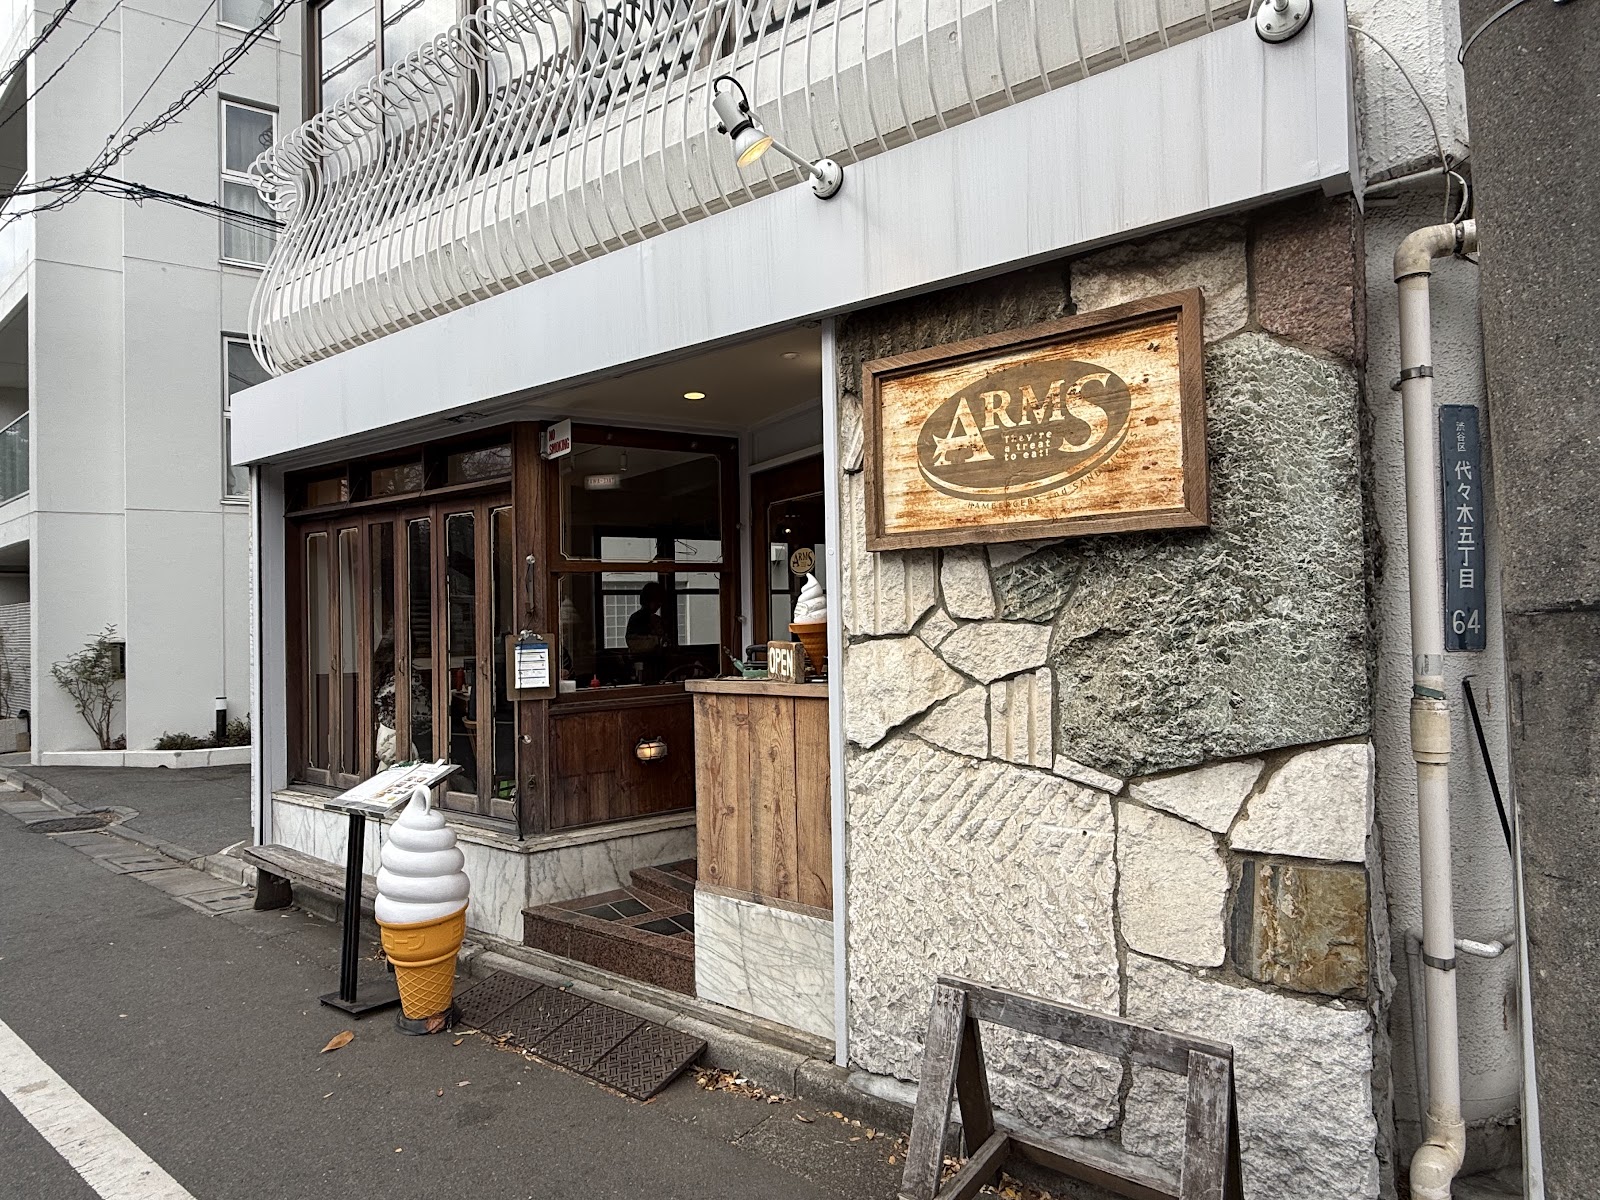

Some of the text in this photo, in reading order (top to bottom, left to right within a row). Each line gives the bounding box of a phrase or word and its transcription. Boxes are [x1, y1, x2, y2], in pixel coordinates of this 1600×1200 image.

[932, 373, 1112, 467] ARMS
[549, 428, 556, 442] NO
[1004, 431, 1053, 444] They're
[1456, 421, 1466, 453] 渋谷区
[549, 437, 570, 455] SMOKING
[1004, 439, 1051, 453] a treat
[1004, 448, 1049, 462] to eat!
[1454, 460, 1475, 589] 代々木五丁目
[792, 551, 813, 567] ARMS
[1452, 609, 1480, 635] 64
[769, 647, 793, 677] OPEN
